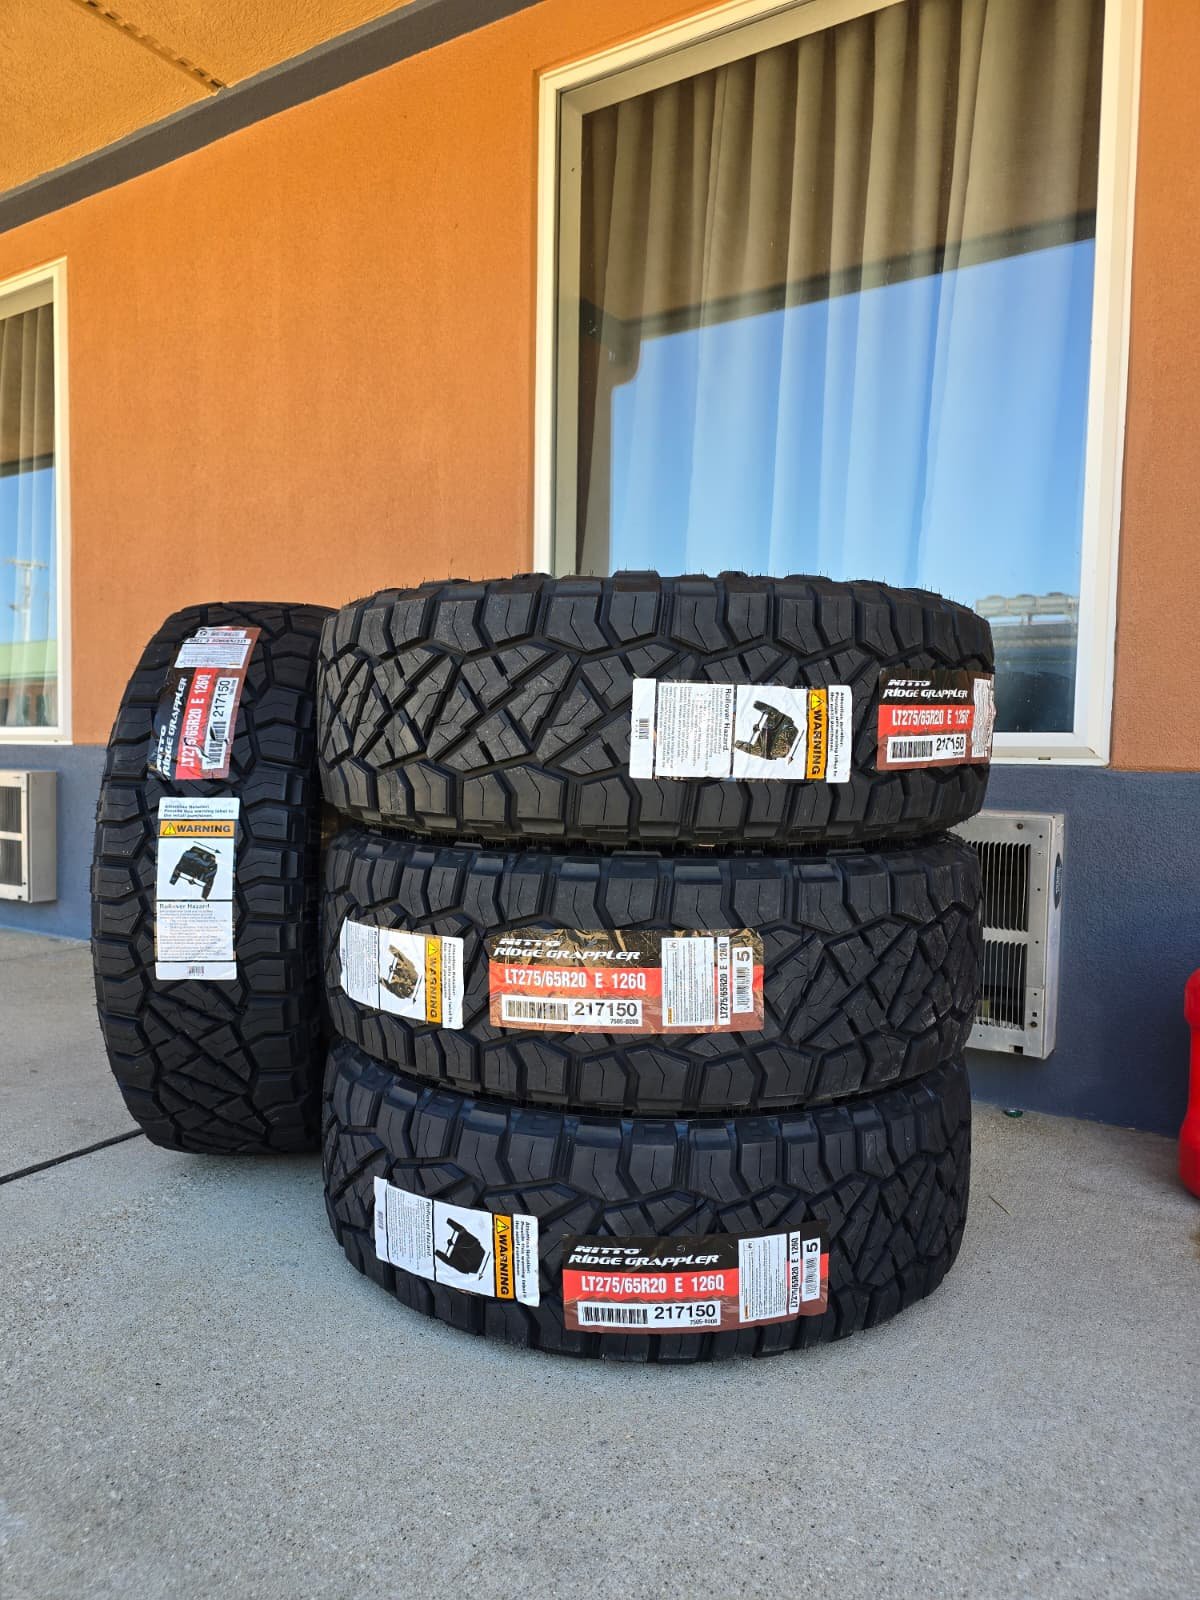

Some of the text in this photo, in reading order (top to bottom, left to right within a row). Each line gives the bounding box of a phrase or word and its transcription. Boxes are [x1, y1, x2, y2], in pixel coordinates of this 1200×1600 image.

[194, 674, 213, 695] 126Q
[213, 680, 231, 718] 217150
[882, 688, 968, 699] RIDGE GRAPPLER
[169, 677, 188, 734] GRAPPLER
[724, 688, 732, 721] Rollover
[892, 709, 944, 726] LT275/65R20
[947, 710, 953, 725] E
[811, 709, 823, 775] WARNING
[936, 736, 965, 752] 217150
[176, 824, 231, 834] WARNING
[499, 938, 561, 948] NITTO
[494, 946, 641, 961] RIDGE GRAPPLER
[736, 950, 750, 962] 5
[430, 957, 438, 1019] WARNING
[504, 968, 647, 991] LT275/65R20 E 126Q
[719, 973, 729, 1019] LT275/65R20
[574, 1001, 638, 1018] 217150
[574, 1245, 640, 1255] NITTO
[806, 1241, 819, 1253] 5
[498, 1234, 509, 1295] WARNING
[568, 1254, 720, 1267] RIDGE GRAPPLER
[581, 1274, 725, 1295] LT275/65R20 E 126Q
[653, 1304, 716, 1320] 217150
